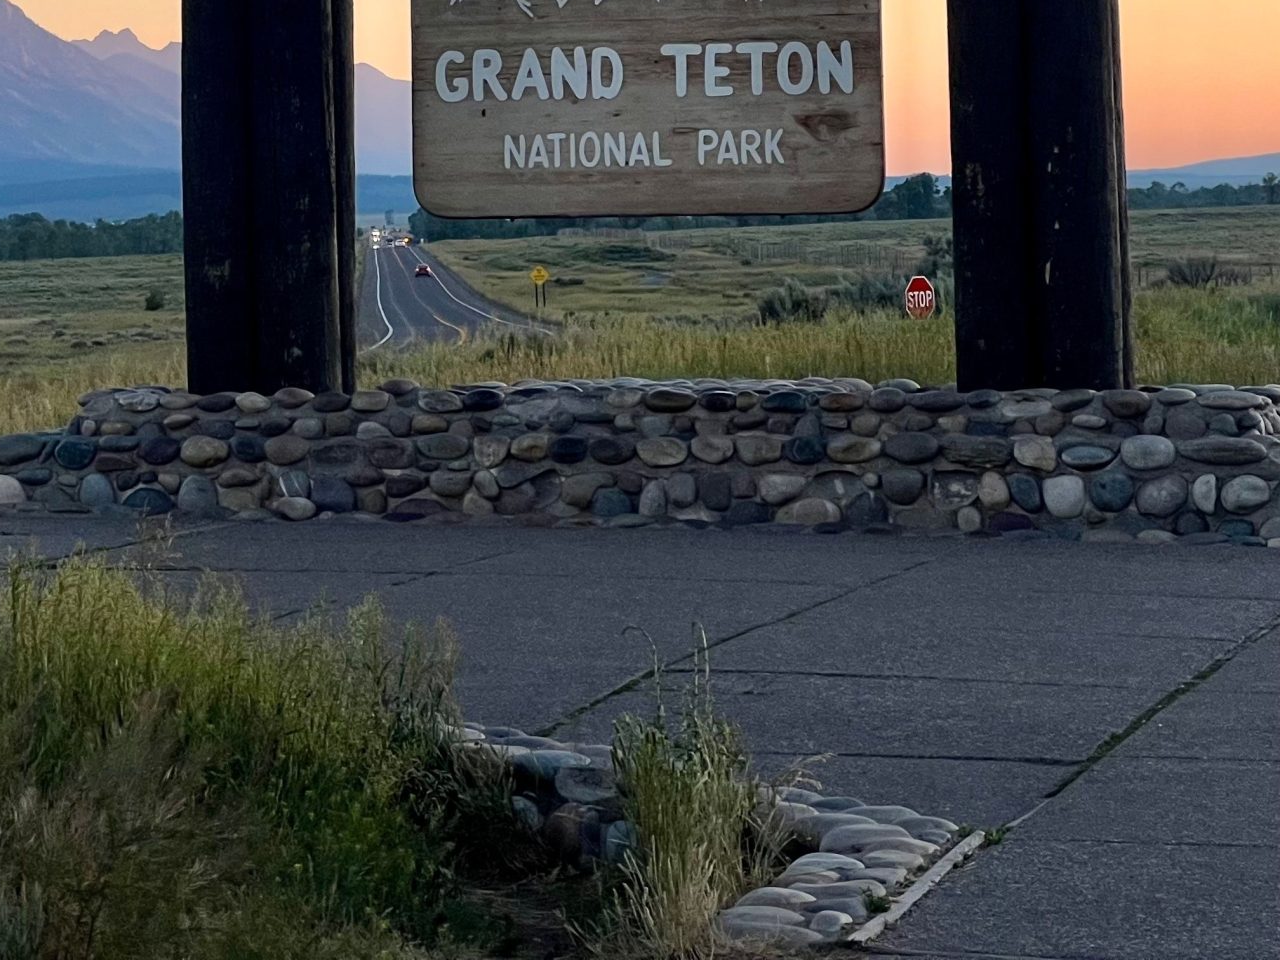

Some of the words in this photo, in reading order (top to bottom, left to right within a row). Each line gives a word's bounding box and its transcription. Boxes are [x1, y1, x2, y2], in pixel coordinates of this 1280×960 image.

[435, 46, 623, 103] GRAND
[660, 40, 854, 97] TETON
[503, 131, 673, 169] NATIONAL
[697, 129, 785, 165] PARK
[908, 290, 932, 308] STOP
